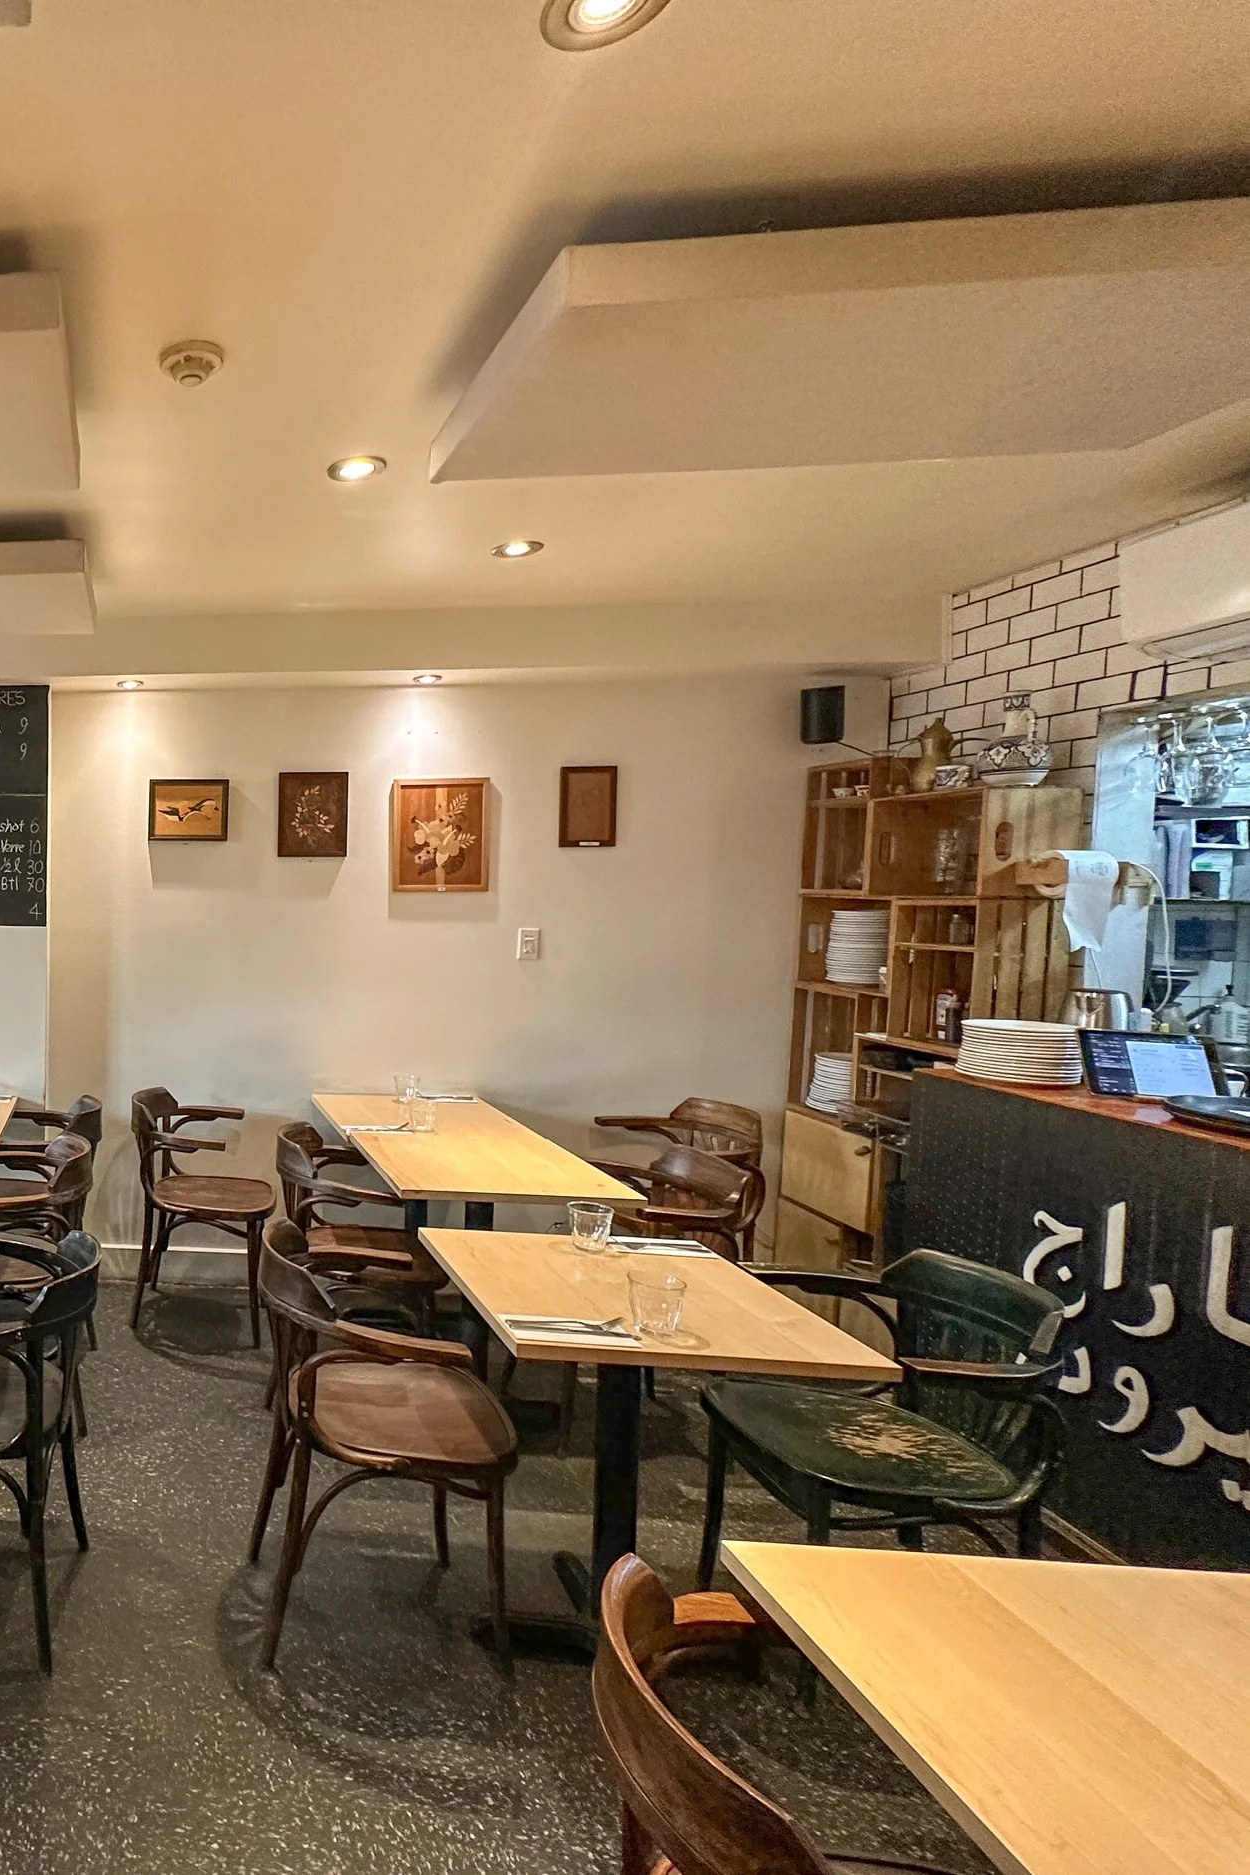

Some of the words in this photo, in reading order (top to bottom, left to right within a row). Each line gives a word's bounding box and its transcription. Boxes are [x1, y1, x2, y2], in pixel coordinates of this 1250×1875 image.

[18, 717, 29, 735] 9
[19, 742, 28, 760] 9
[0, 818, 25, 833] shot
[30, 818, 40, 834] 6
[0, 838, 25, 853] Verre
[29, 840, 42, 855] 10
[27, 859, 44, 875] 30
[1, 876, 19, 891] Btl
[26, 876, 45, 893] 70
[29, 902, 43, 920] 4
